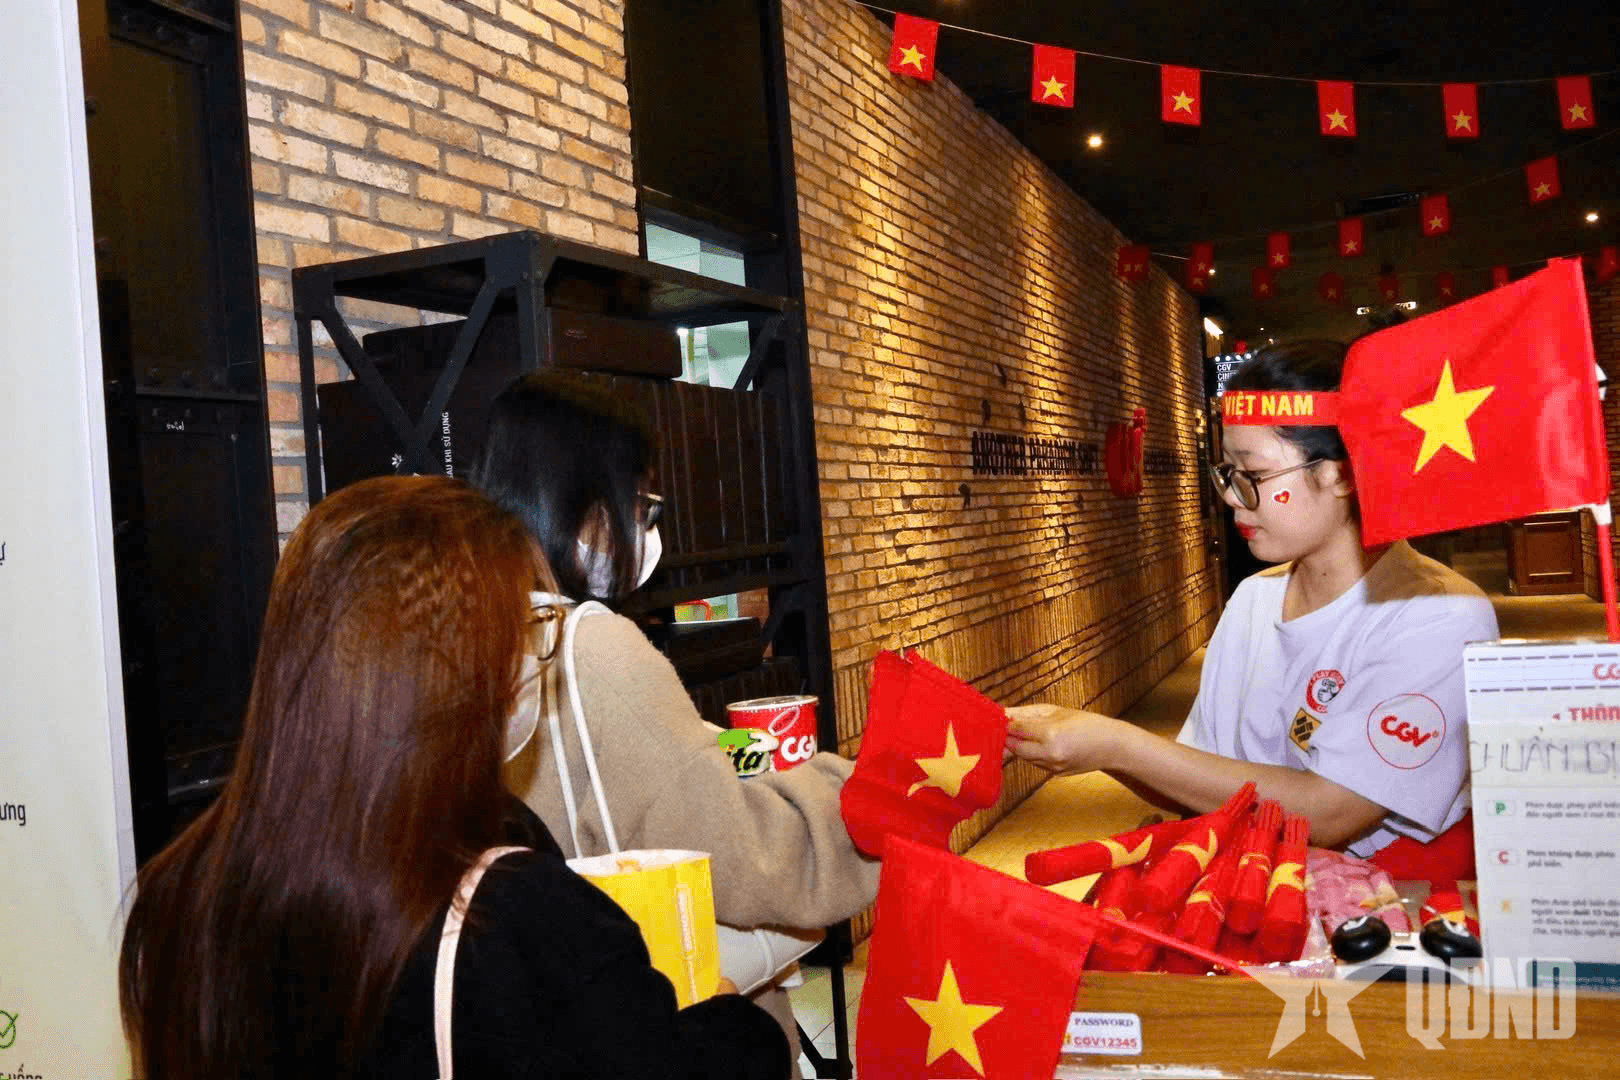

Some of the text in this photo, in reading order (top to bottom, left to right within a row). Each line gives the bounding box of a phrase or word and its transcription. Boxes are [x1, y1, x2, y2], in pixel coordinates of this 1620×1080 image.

[1217, 373, 1233, 381] CIN
[1224, 391, 1313, 420] VIỆT NAM
[442, 412, 451, 434] DỤNG
[441, 436, 451, 448] SỬ
[1380, 715, 1432, 747] CGV
[1495, 801, 1507, 815] P
[1497, 850, 1509, 865] C
[1074, 1018, 1134, 1027] PASSWORD
[1074, 1036, 1137, 1048] CGV12345
